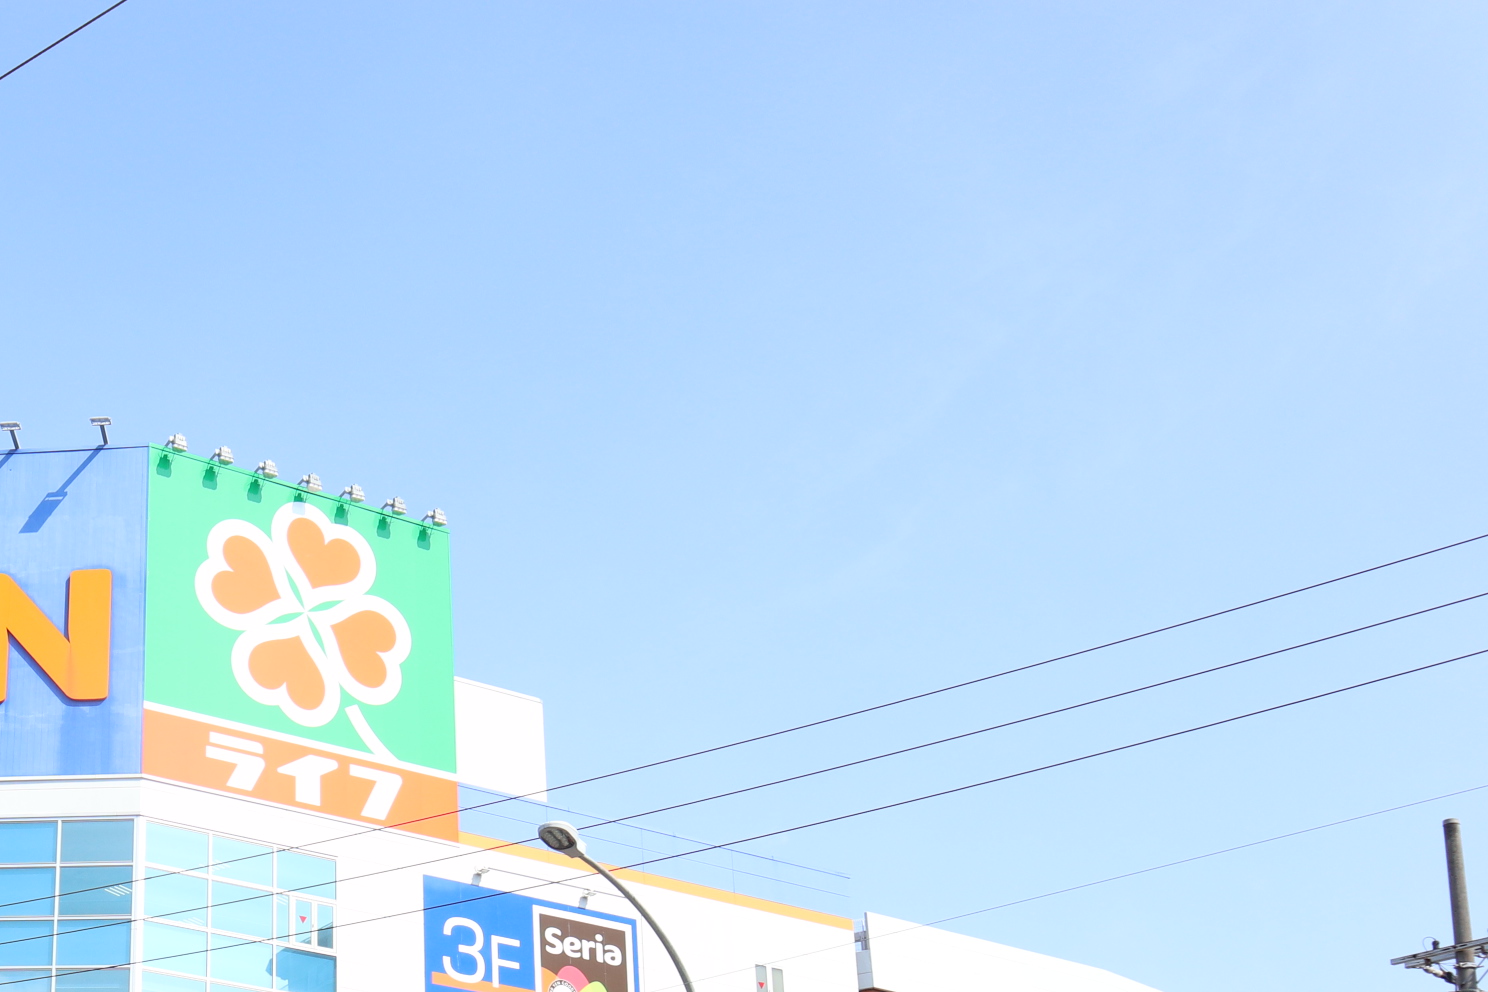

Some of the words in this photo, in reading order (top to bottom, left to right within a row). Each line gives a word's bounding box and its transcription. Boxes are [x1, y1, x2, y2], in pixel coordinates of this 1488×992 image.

[203, 729, 405, 822] ライフ
[442, 916, 521, 988] 3F
[543, 926, 623, 967] Seria
